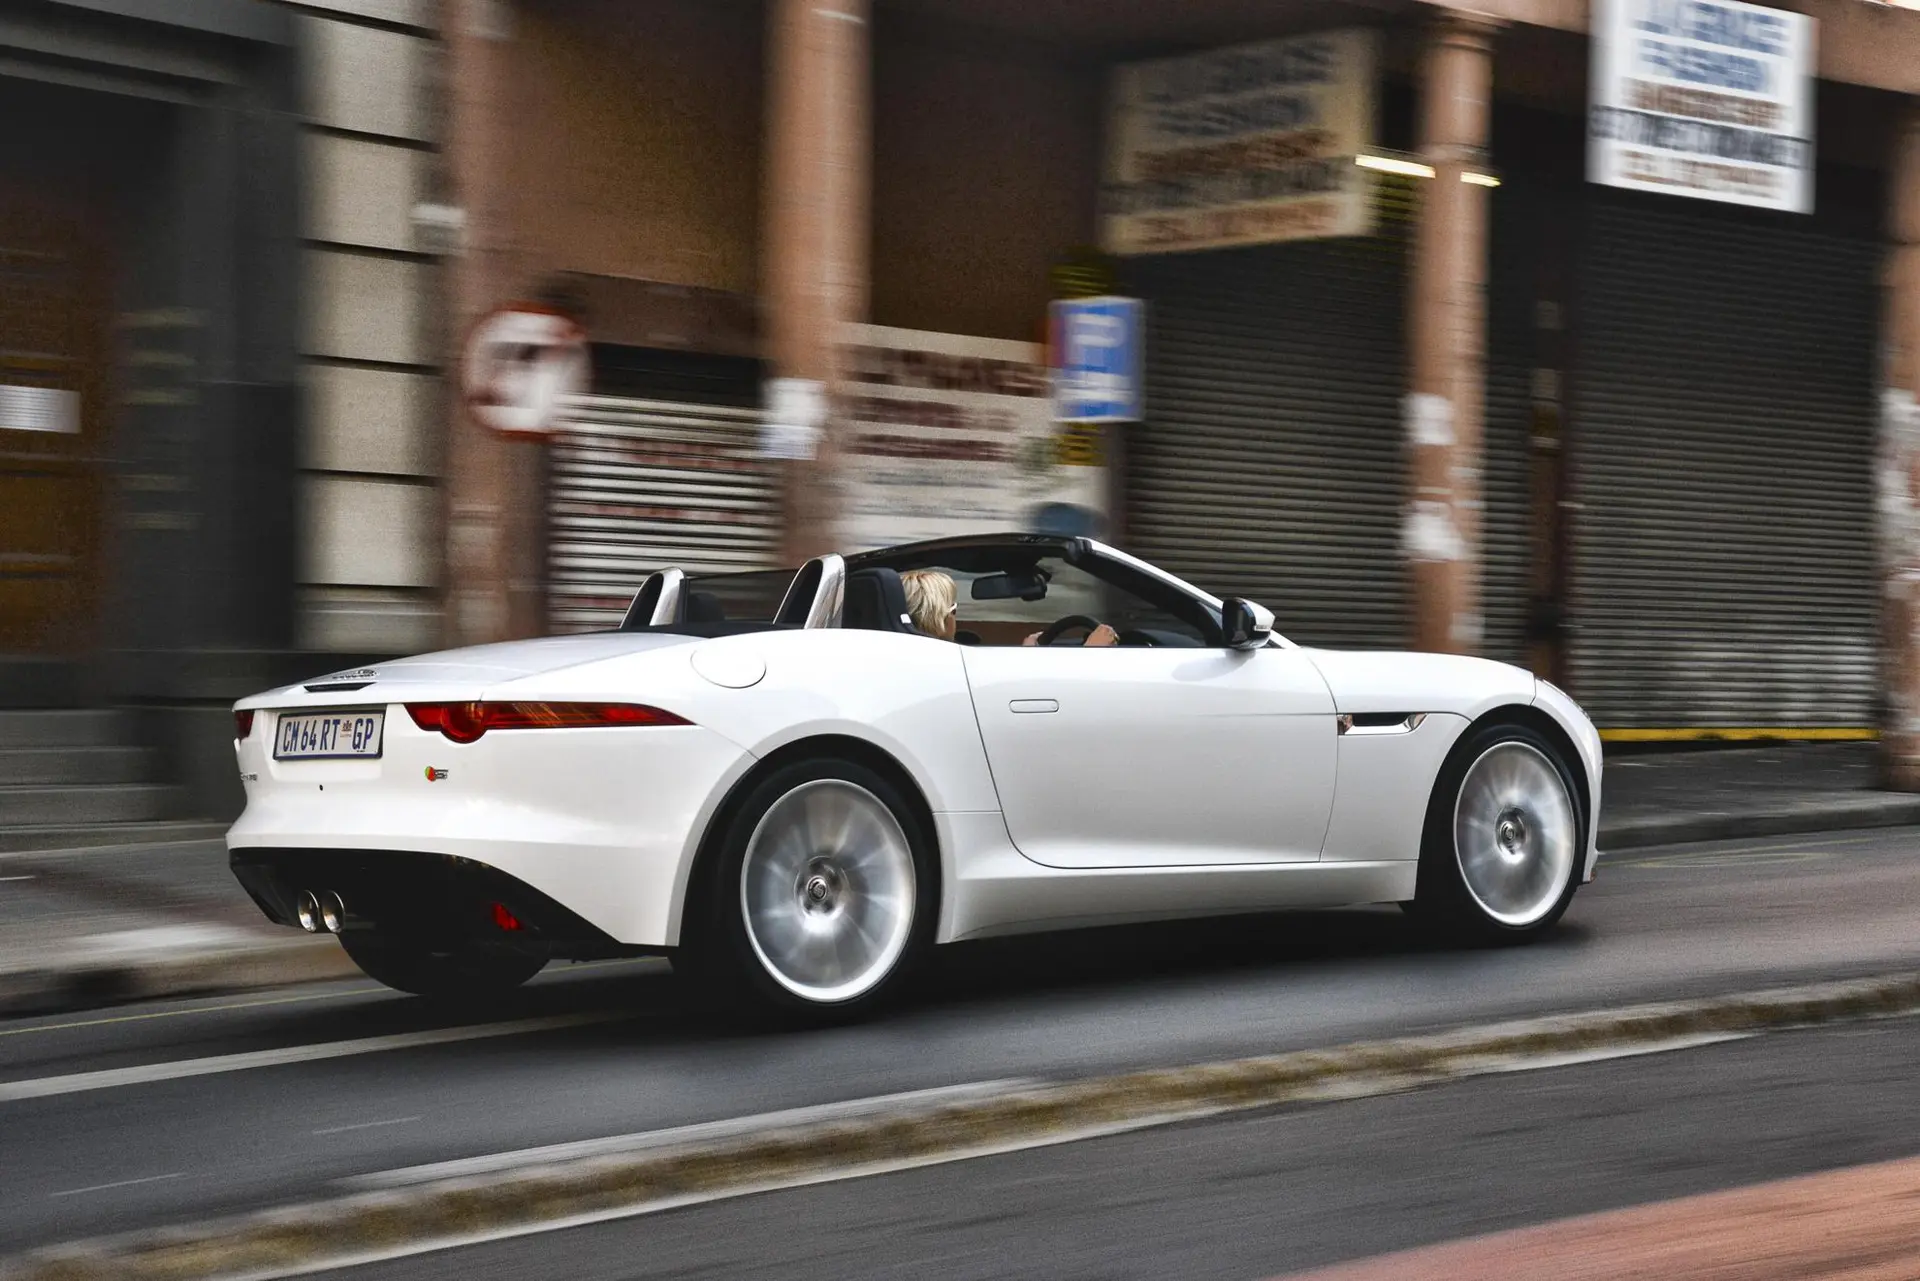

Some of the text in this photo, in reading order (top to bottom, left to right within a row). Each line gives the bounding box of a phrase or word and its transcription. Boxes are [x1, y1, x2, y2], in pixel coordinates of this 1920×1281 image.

[283, 718, 374, 752] CM 64 RT GP
